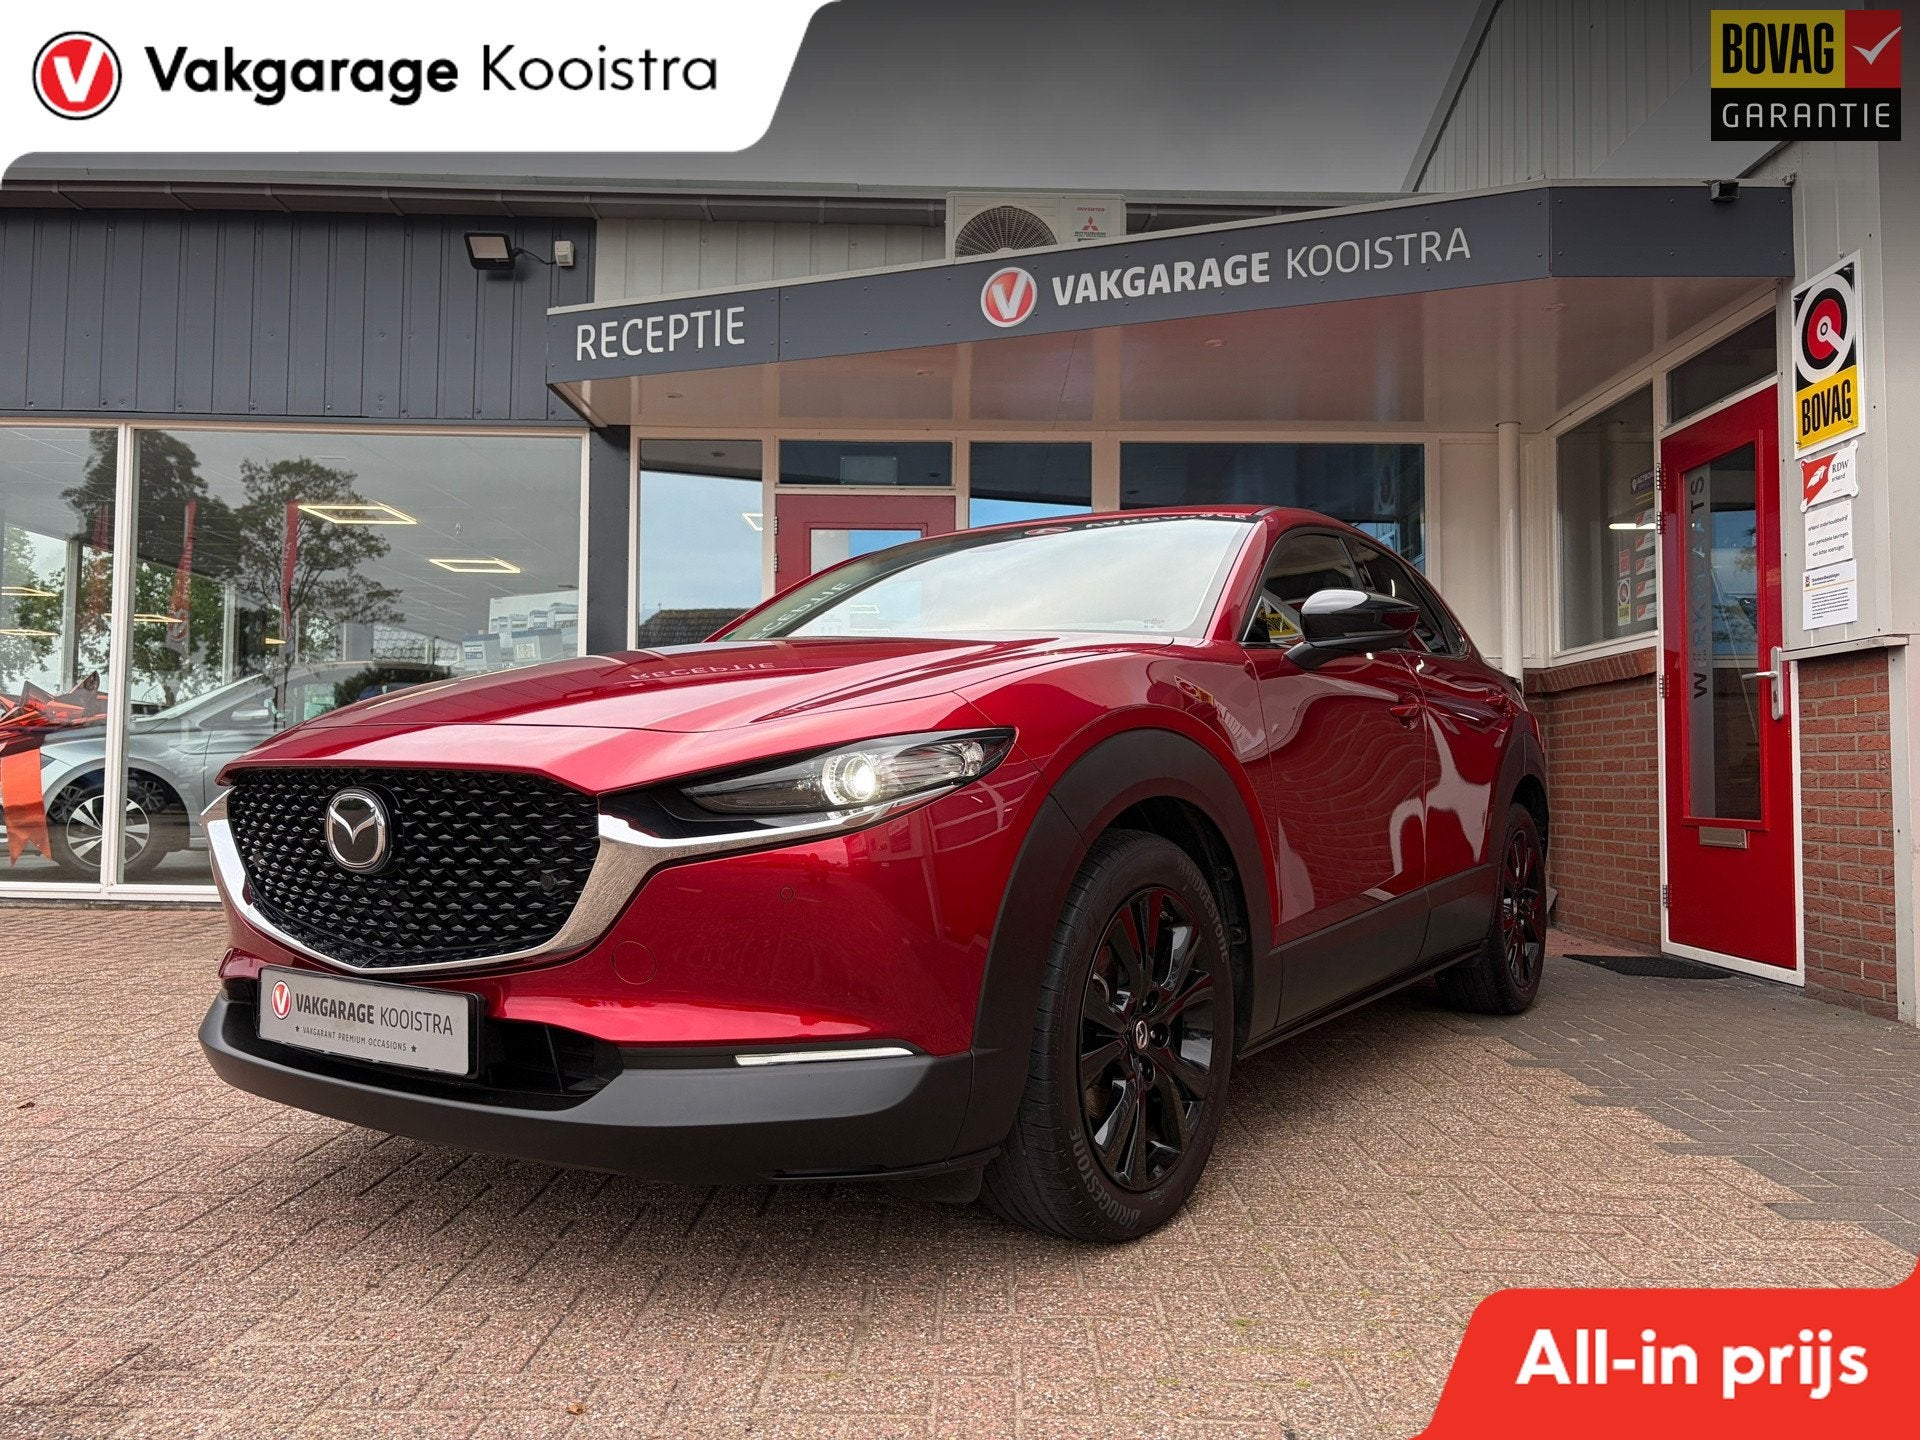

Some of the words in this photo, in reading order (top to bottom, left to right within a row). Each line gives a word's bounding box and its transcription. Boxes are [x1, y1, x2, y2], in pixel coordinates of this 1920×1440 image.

[1052, 252, 1270, 306] VAKGARAGE
[1286, 227, 1472, 280] KOOISTRA
[576, 306, 745, 361] RECEPTIE
[1802, 379, 1851, 436] BOVAG
[1832, 460, 1849, 473] RDW
[296, 993, 375, 1024] VAKGARAGE
[380, 1006, 454, 1036] KOOISTRA
[302, 1026, 336, 1040] VAKGARANT
[338, 1032, 366, 1046] PREMIUM
[368, 1038, 407, 1051] OCCASIONS
